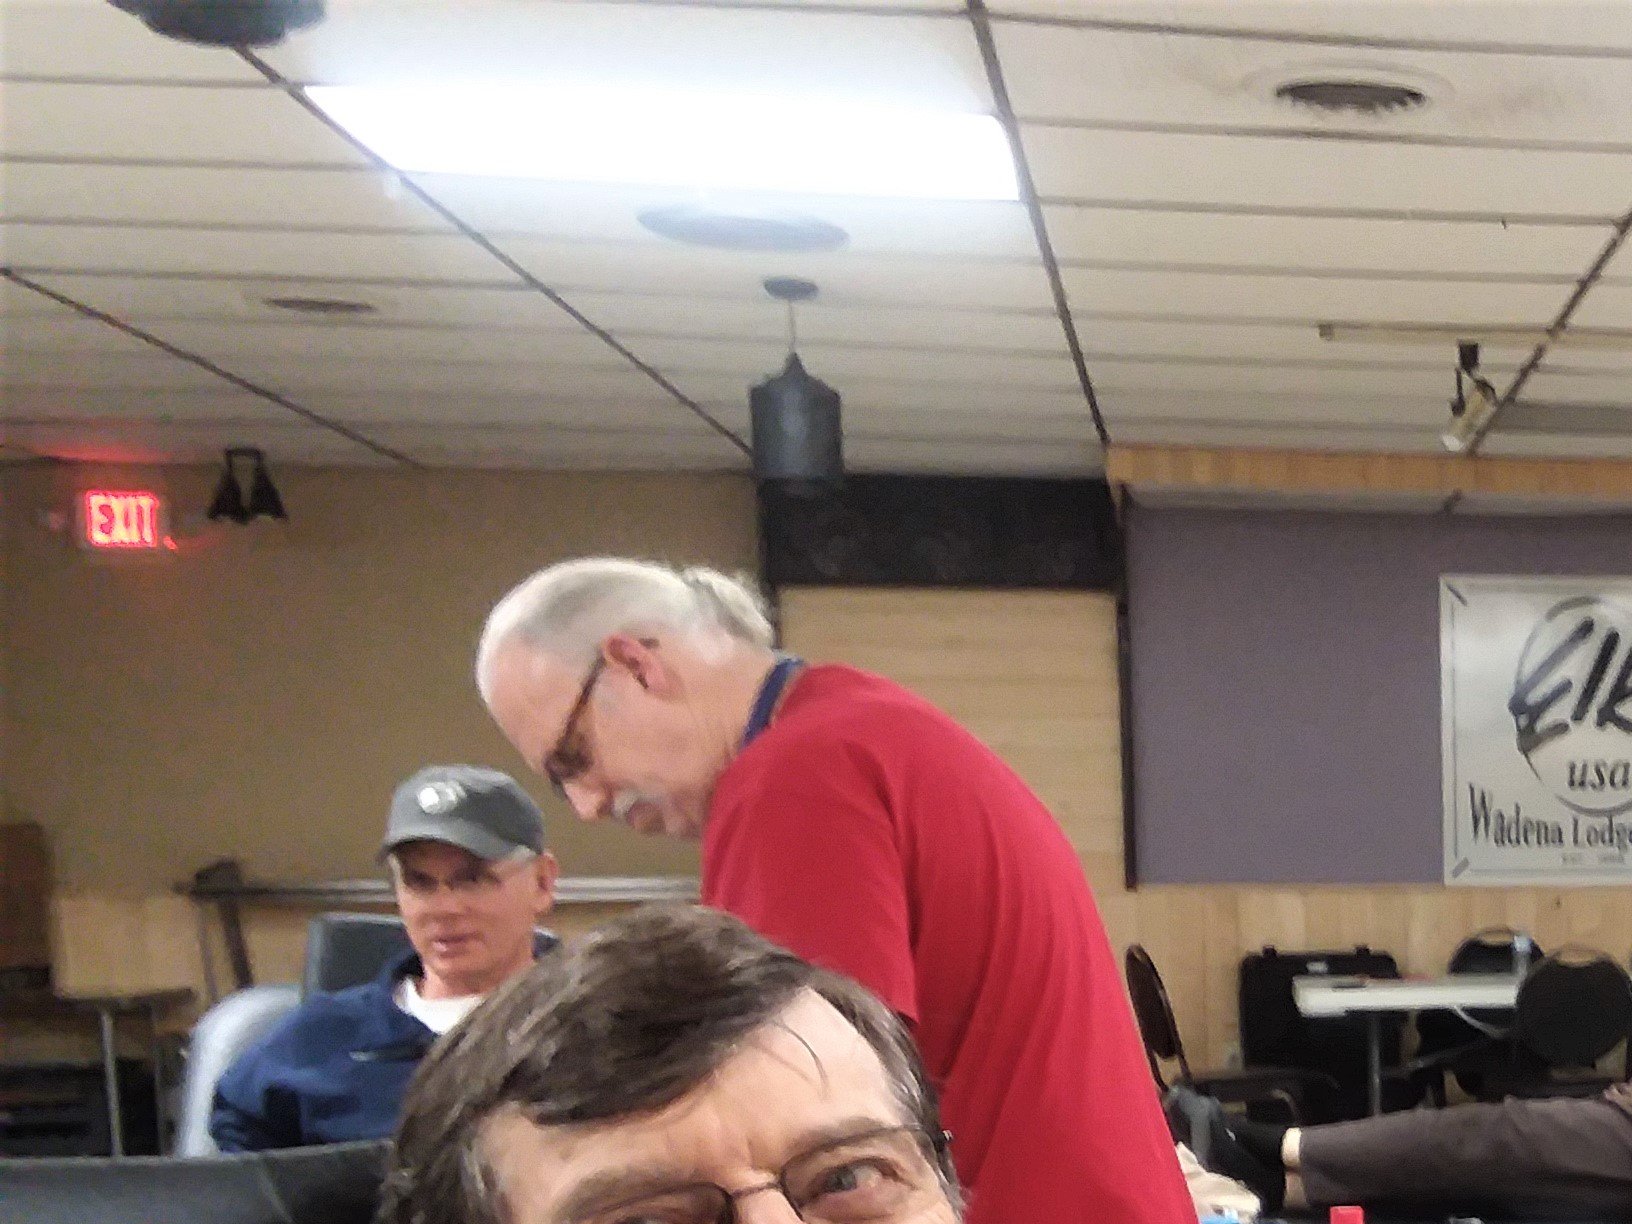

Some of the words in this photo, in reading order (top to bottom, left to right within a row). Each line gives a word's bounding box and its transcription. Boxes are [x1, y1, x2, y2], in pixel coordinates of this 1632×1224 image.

[89, 495, 155, 544] EXIT
[1567, 759, 1632, 791] usa
[1468, 782, 1564, 848] Wadena
